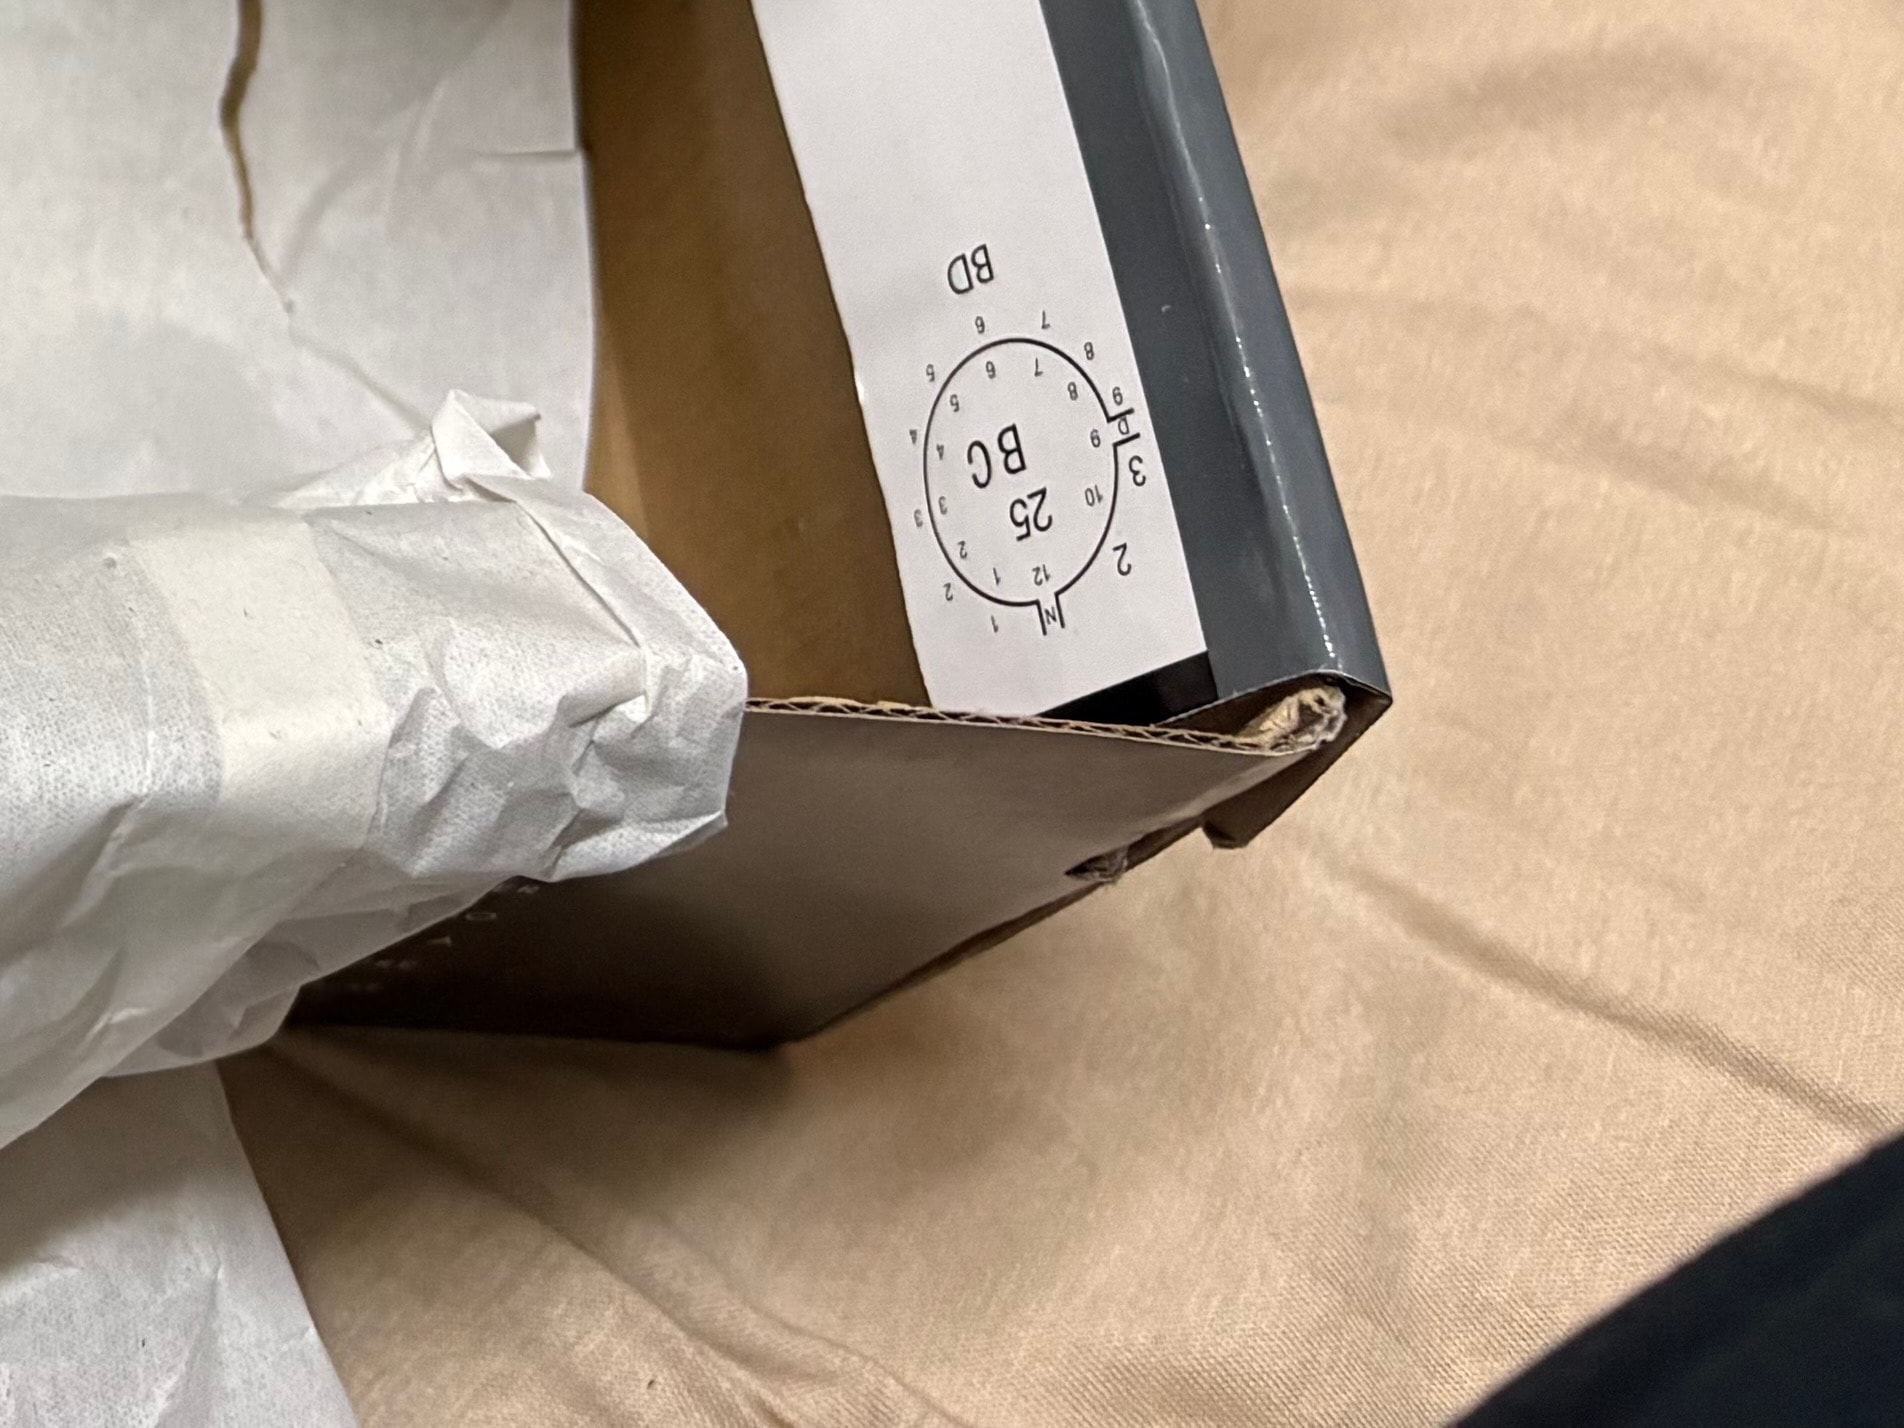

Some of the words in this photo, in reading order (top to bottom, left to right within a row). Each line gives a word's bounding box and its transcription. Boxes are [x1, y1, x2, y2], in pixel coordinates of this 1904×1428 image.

[947, 244, 995, 295] BD
[1083, 341, 1096, 362] 8
[1066, 381, 1079, 402] 8
[1127, 454, 1147, 488] 3
[1084, 484, 1104, 508] 10
[1008, 486, 1054, 543] 25
[1111, 541, 1133, 577] 2
[1031, 563, 1052, 587] 12
[1043, 605, 1058, 626] N
